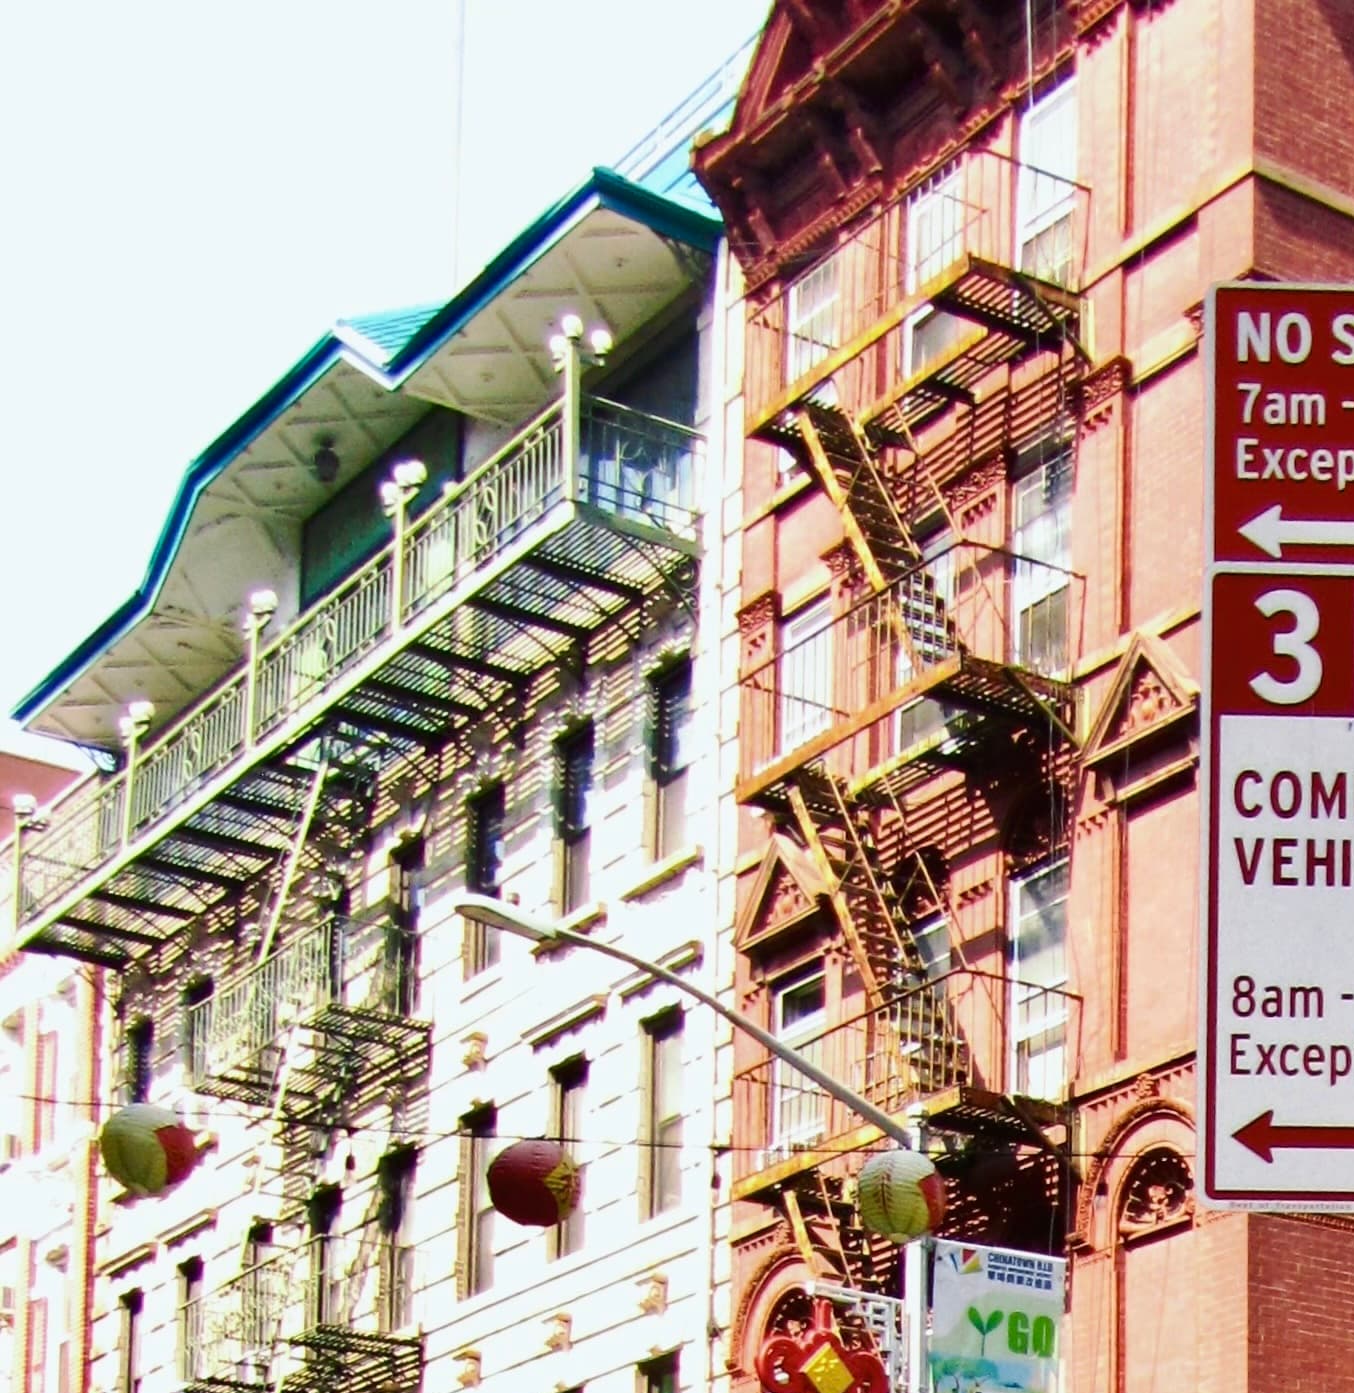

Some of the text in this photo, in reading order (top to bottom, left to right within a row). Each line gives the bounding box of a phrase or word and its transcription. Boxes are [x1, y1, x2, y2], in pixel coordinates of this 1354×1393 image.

[1237, 311, 1312, 364] NO
[1237, 382, 1326, 425] 7am
[1248, 589, 1324, 705] 3
[1232, 975, 1325, 1019] 8am
[1007, 1310, 1056, 1359] GO
